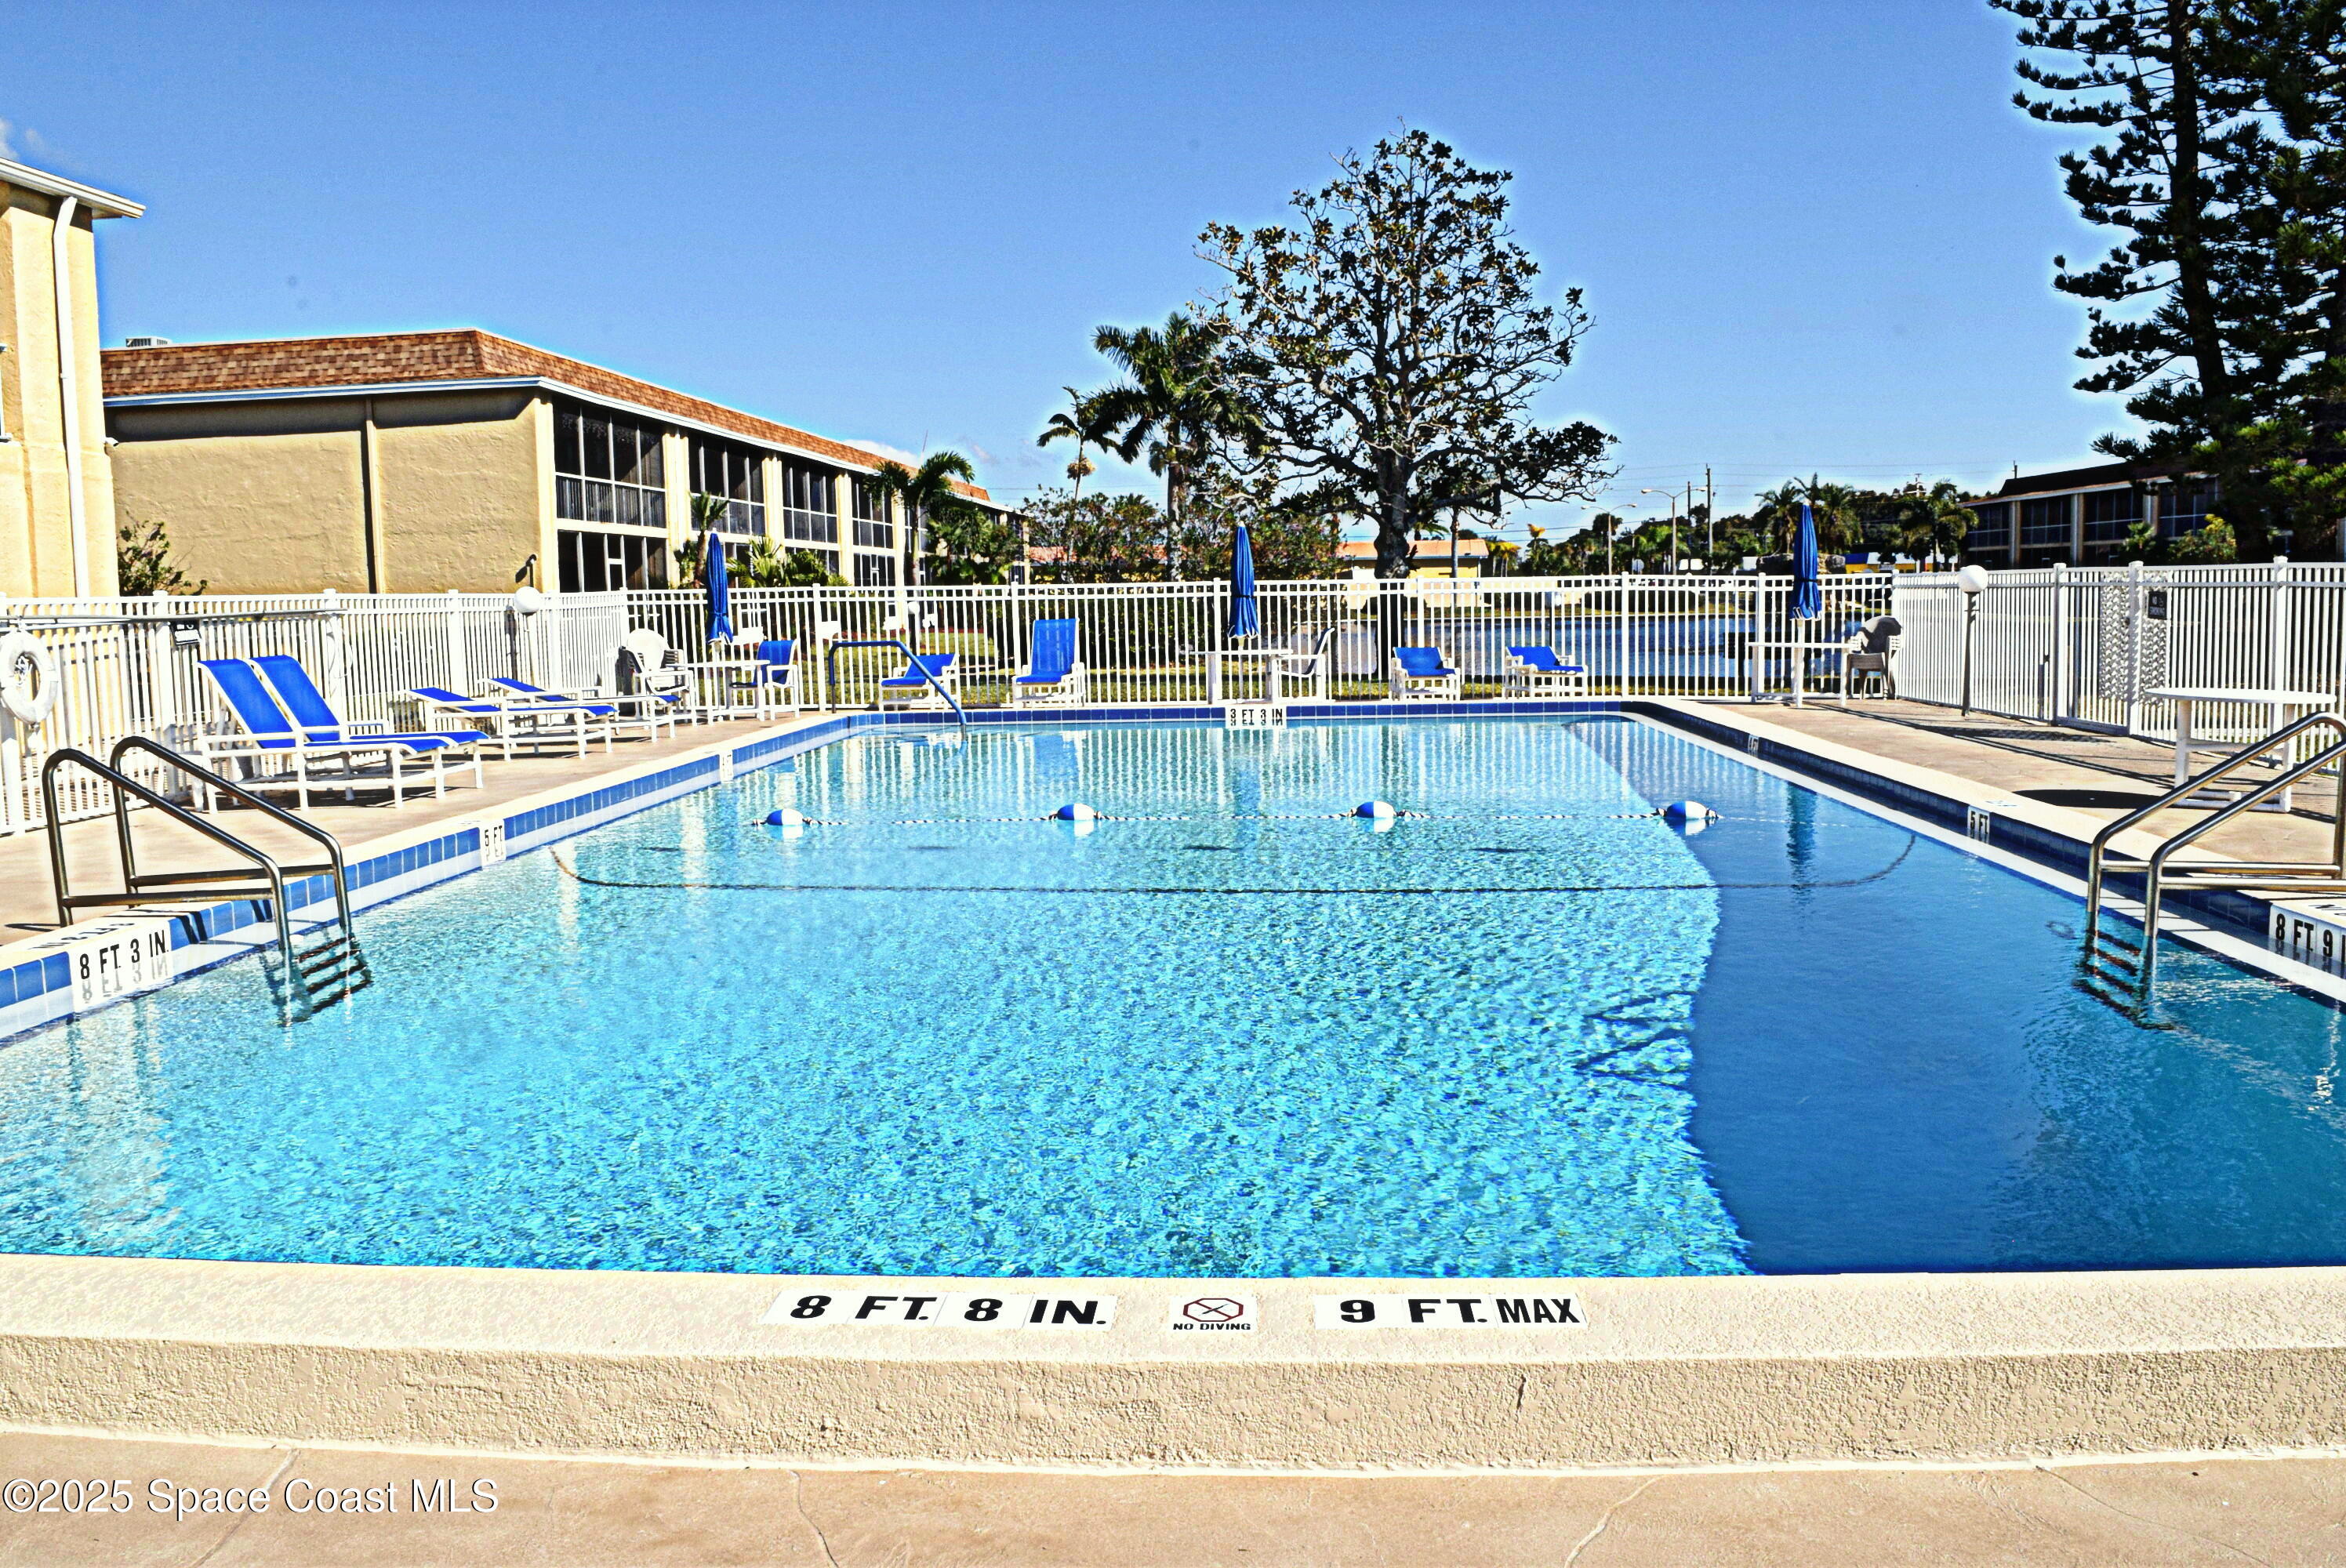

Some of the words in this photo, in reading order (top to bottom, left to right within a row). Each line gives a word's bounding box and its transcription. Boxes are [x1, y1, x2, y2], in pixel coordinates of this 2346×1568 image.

[1970, 811, 1976, 829] 5
[485, 829, 489, 847] 5
[2275, 913, 2286, 941] 8
[2322, 929, 2333, 957] 9
[79, 953, 90, 980] 8
[130, 938, 140, 964] 3
[790, 1295, 832, 1319] 8
[855, 1295, 938, 1320] FT.
[964, 1298, 1003, 1322] 8
[1030, 1299, 1107, 1325] IN.
[1340, 1299, 1375, 1323] 9
[1407, 1298, 1487, 1323] FT.
[1495, 1298, 1581, 1323] MAX
